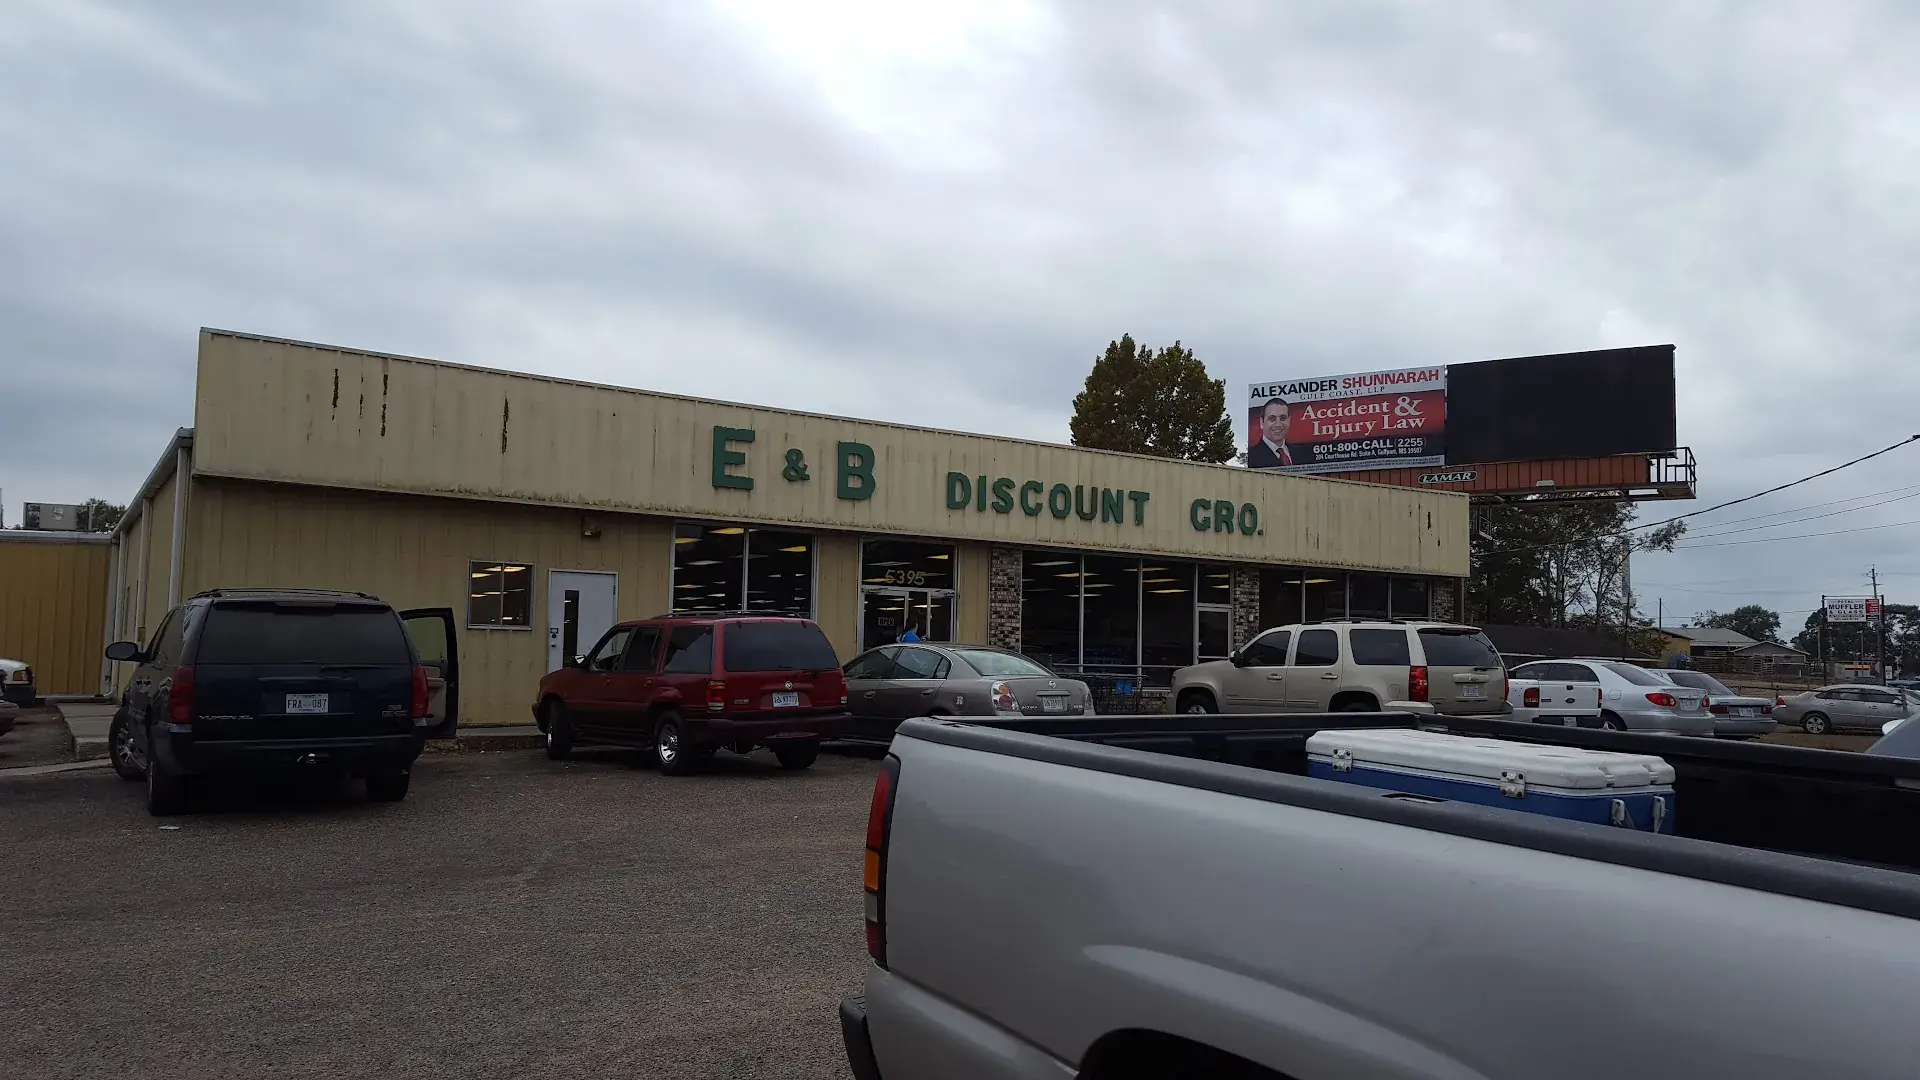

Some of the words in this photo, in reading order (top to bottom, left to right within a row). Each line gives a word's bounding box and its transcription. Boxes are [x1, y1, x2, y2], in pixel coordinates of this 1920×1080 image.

[1251, 380, 1338, 398] ALEXANDER
[1342, 369, 1439, 389] SHUNNARAH
[1368, 386, 1385, 394] LLP
[1301, 400, 1390, 420] Accident
[1394, 396, 1424, 417] &
[1312, 420, 1378, 439] Injury
[1382, 414, 1427, 430] Law
[1313, 439, 1394, 453] 601-800-CALL
[712, 426, 755, 490] E
[783, 448, 811, 482] &
[837, 440, 876, 501] B
[946, 471, 1150, 526] DISCOUNT
[1190, 498, 1264, 536] GRO.
[1422, 472, 1472, 483] LAMAR
[885, 569, 925, 586] 5395
